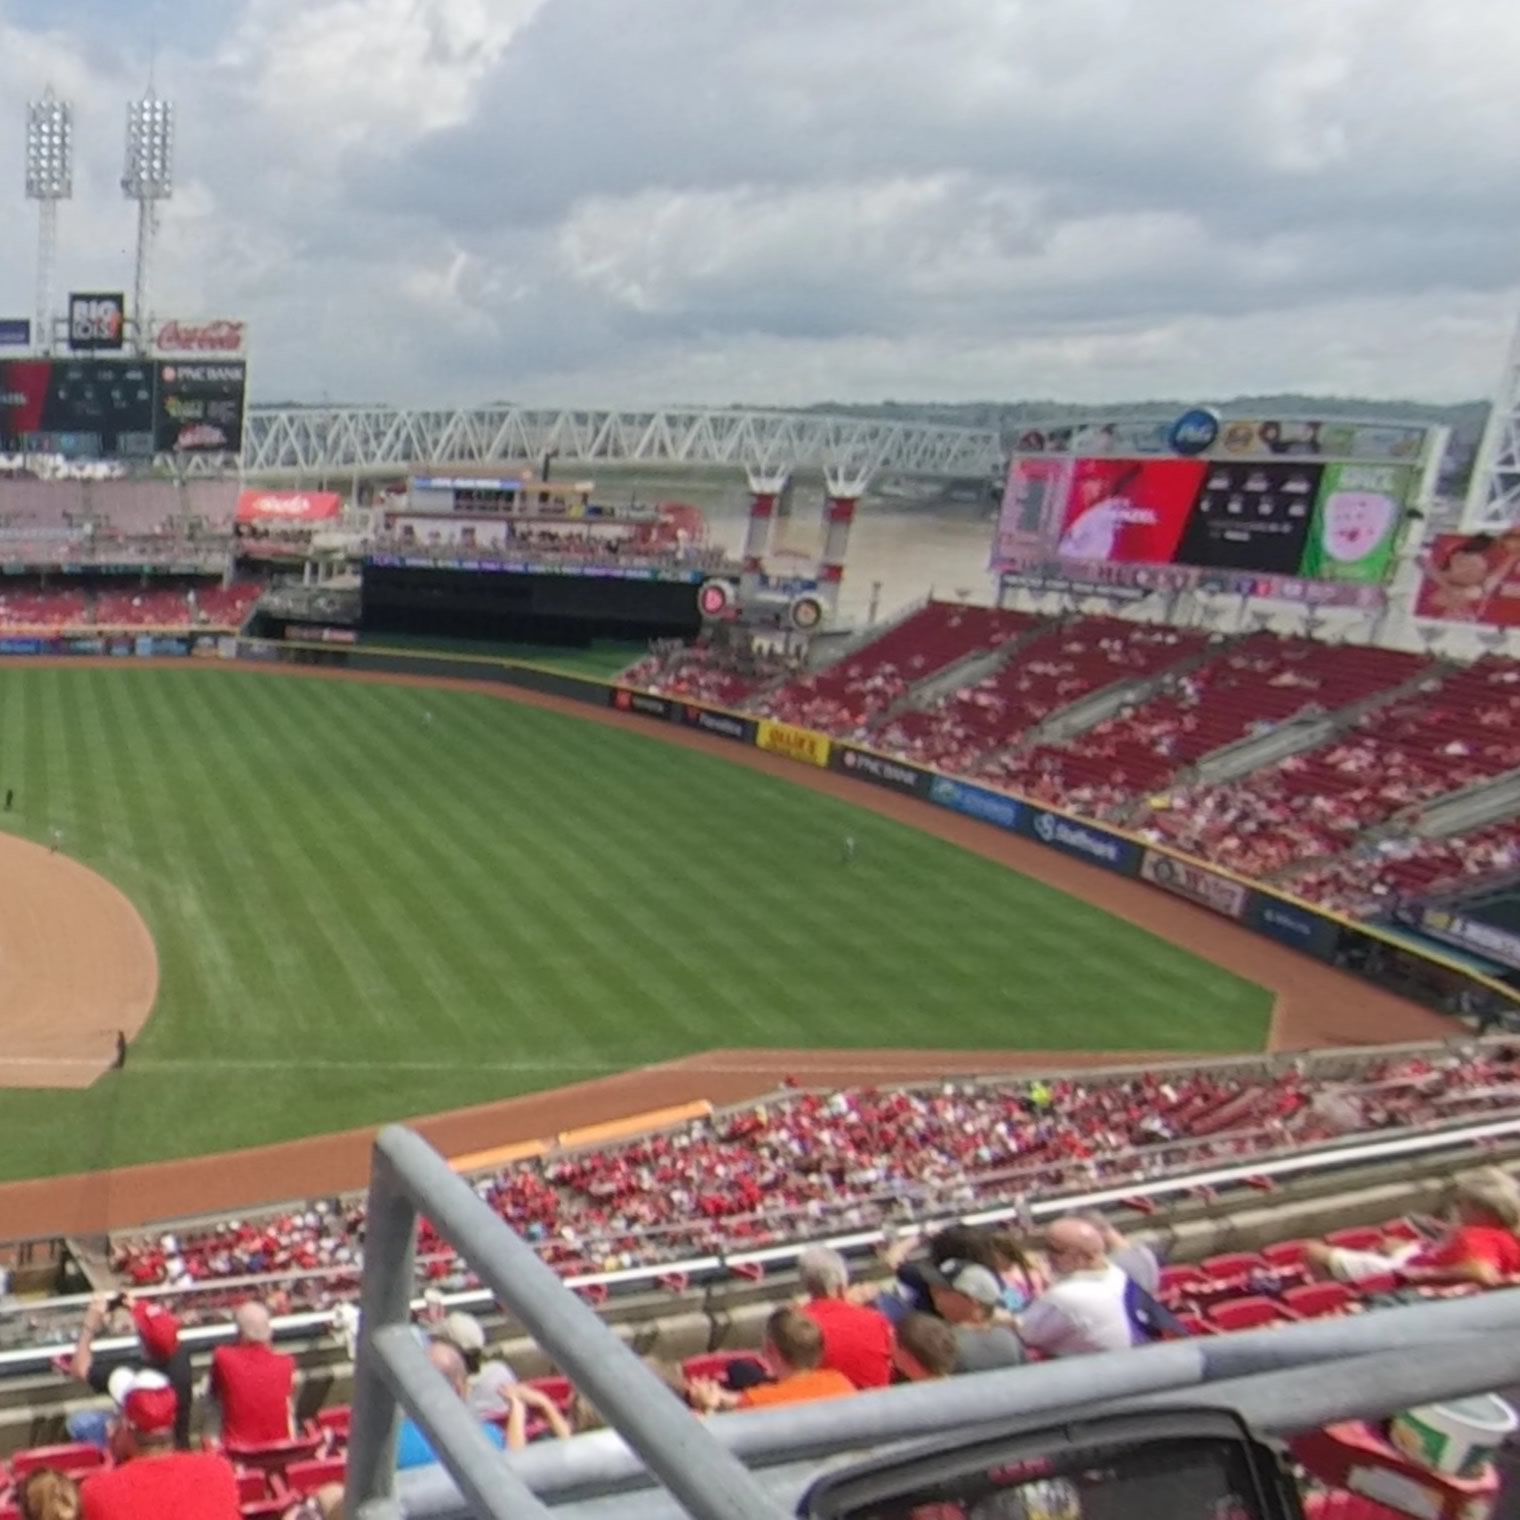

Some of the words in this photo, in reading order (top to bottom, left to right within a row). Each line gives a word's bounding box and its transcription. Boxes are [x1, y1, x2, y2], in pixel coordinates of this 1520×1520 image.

[73, 299, 117, 317] BIG
[177, 366, 206, 381] PNC
[207, 366, 243, 381] BANK
